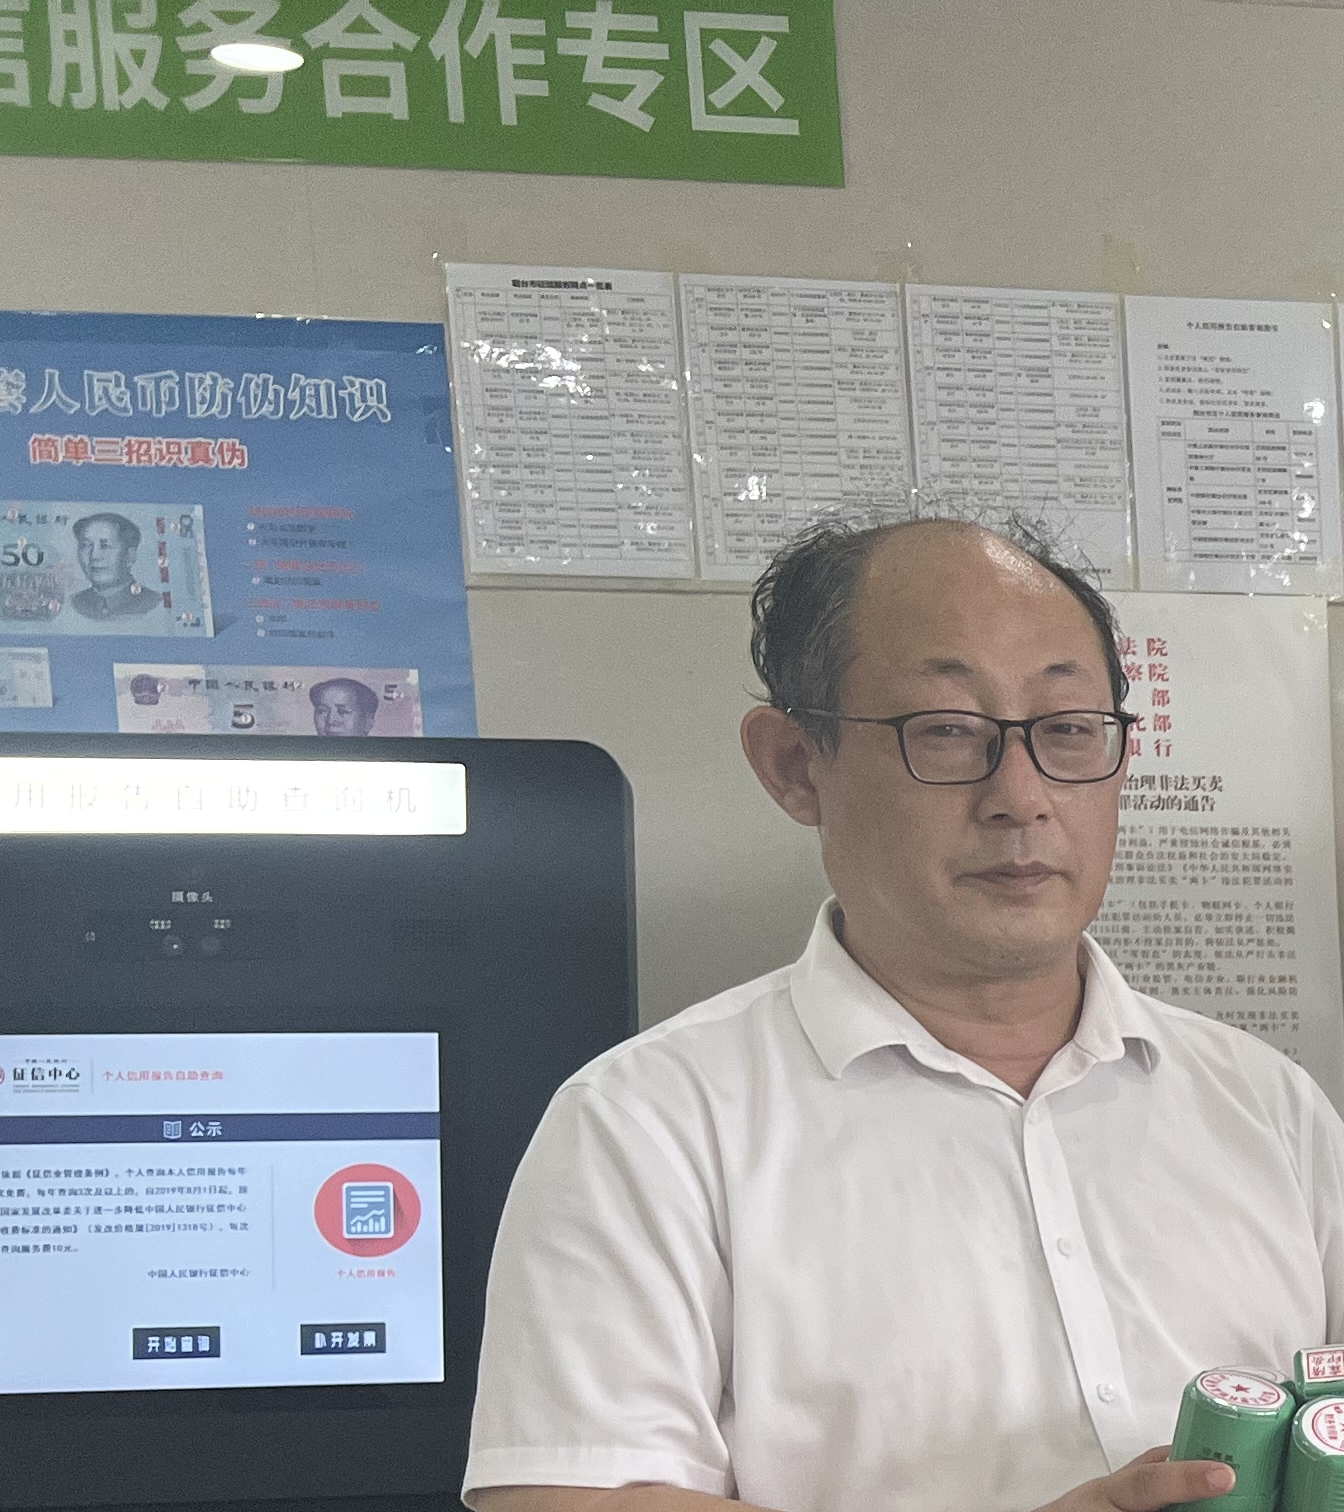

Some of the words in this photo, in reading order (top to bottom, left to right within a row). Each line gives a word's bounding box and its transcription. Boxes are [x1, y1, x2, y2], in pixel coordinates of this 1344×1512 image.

[29, 434, 248, 468] 简单三招识真伪
[1, 542, 45, 567] 50
[1152, 688, 1170, 707] 部
[14, 780, 417, 815] 用报告自助查询机
[13, 1067, 80, 1081] 征信中心
[189, 1121, 223, 1137] 公示
